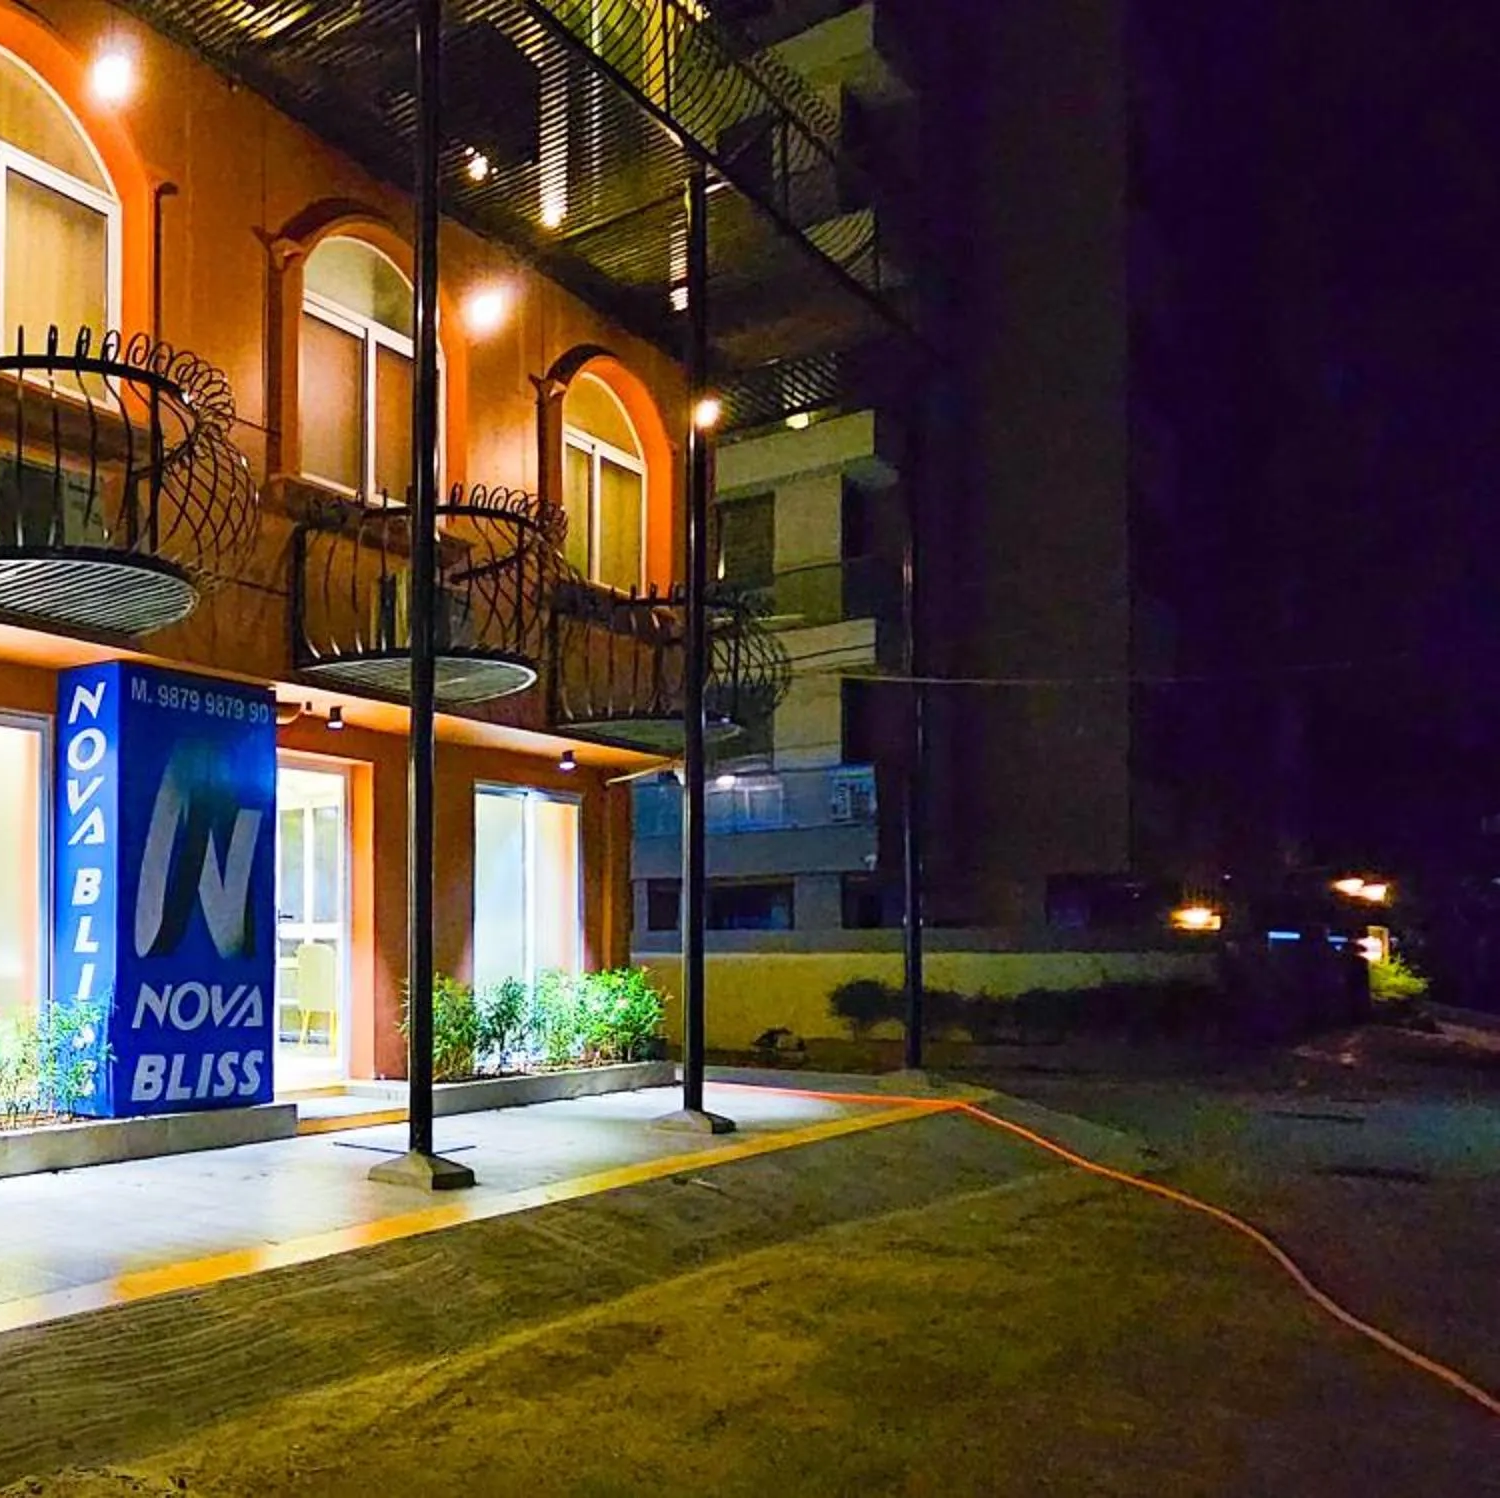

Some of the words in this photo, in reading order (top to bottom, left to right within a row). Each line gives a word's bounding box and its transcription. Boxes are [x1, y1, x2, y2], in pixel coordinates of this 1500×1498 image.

[131, 676, 151, 703] M.
[157, 684, 200, 712] 9879
[205, 691, 245, 720] 9879
[67, 681, 107, 845] NOVA
[131, 981, 264, 1031] NOVA
[131, 1049, 264, 1101] BLISS
